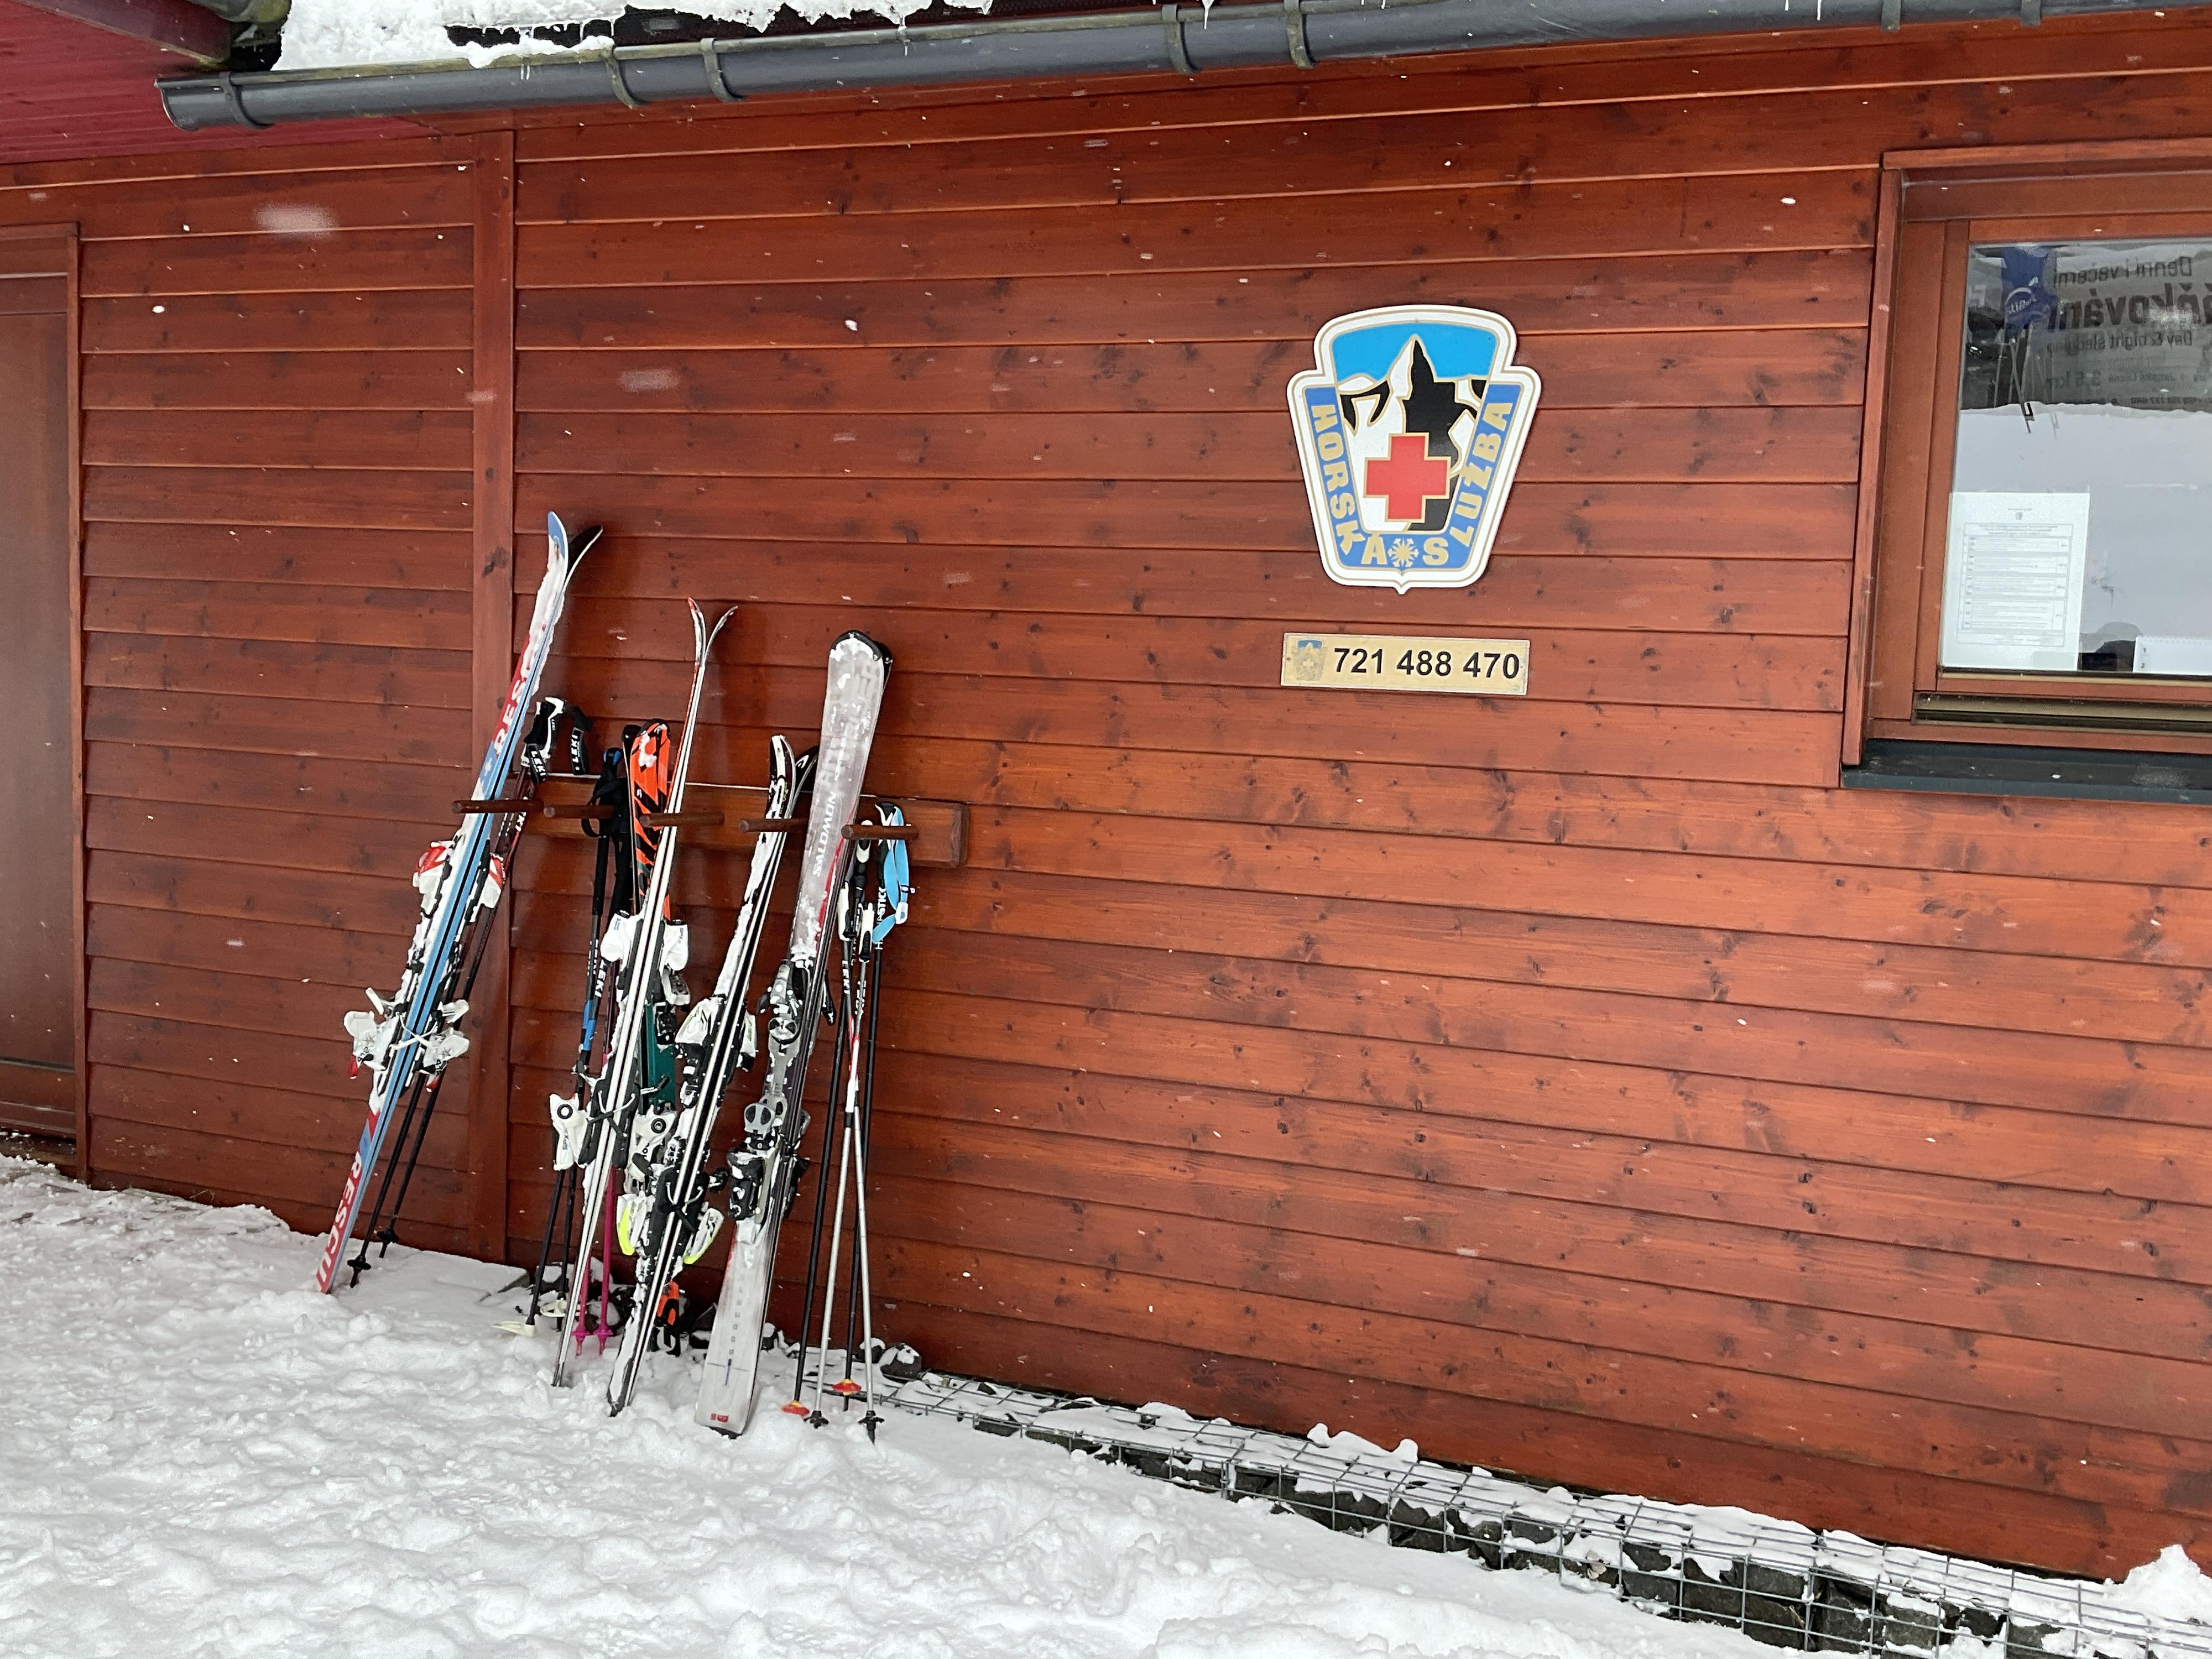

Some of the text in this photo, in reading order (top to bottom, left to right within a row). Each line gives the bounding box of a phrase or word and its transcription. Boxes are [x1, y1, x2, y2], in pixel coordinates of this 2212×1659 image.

[1311, 403, 1512, 566] HORSKÁ SLUŽBA
[1334, 648, 1520, 679] 721 488 470
[531, 750, 546, 776] LEKI
[813, 792, 838, 878] SALOMON
[594, 959, 606, 998] LEKI
[842, 959, 851, 995] LEKI
